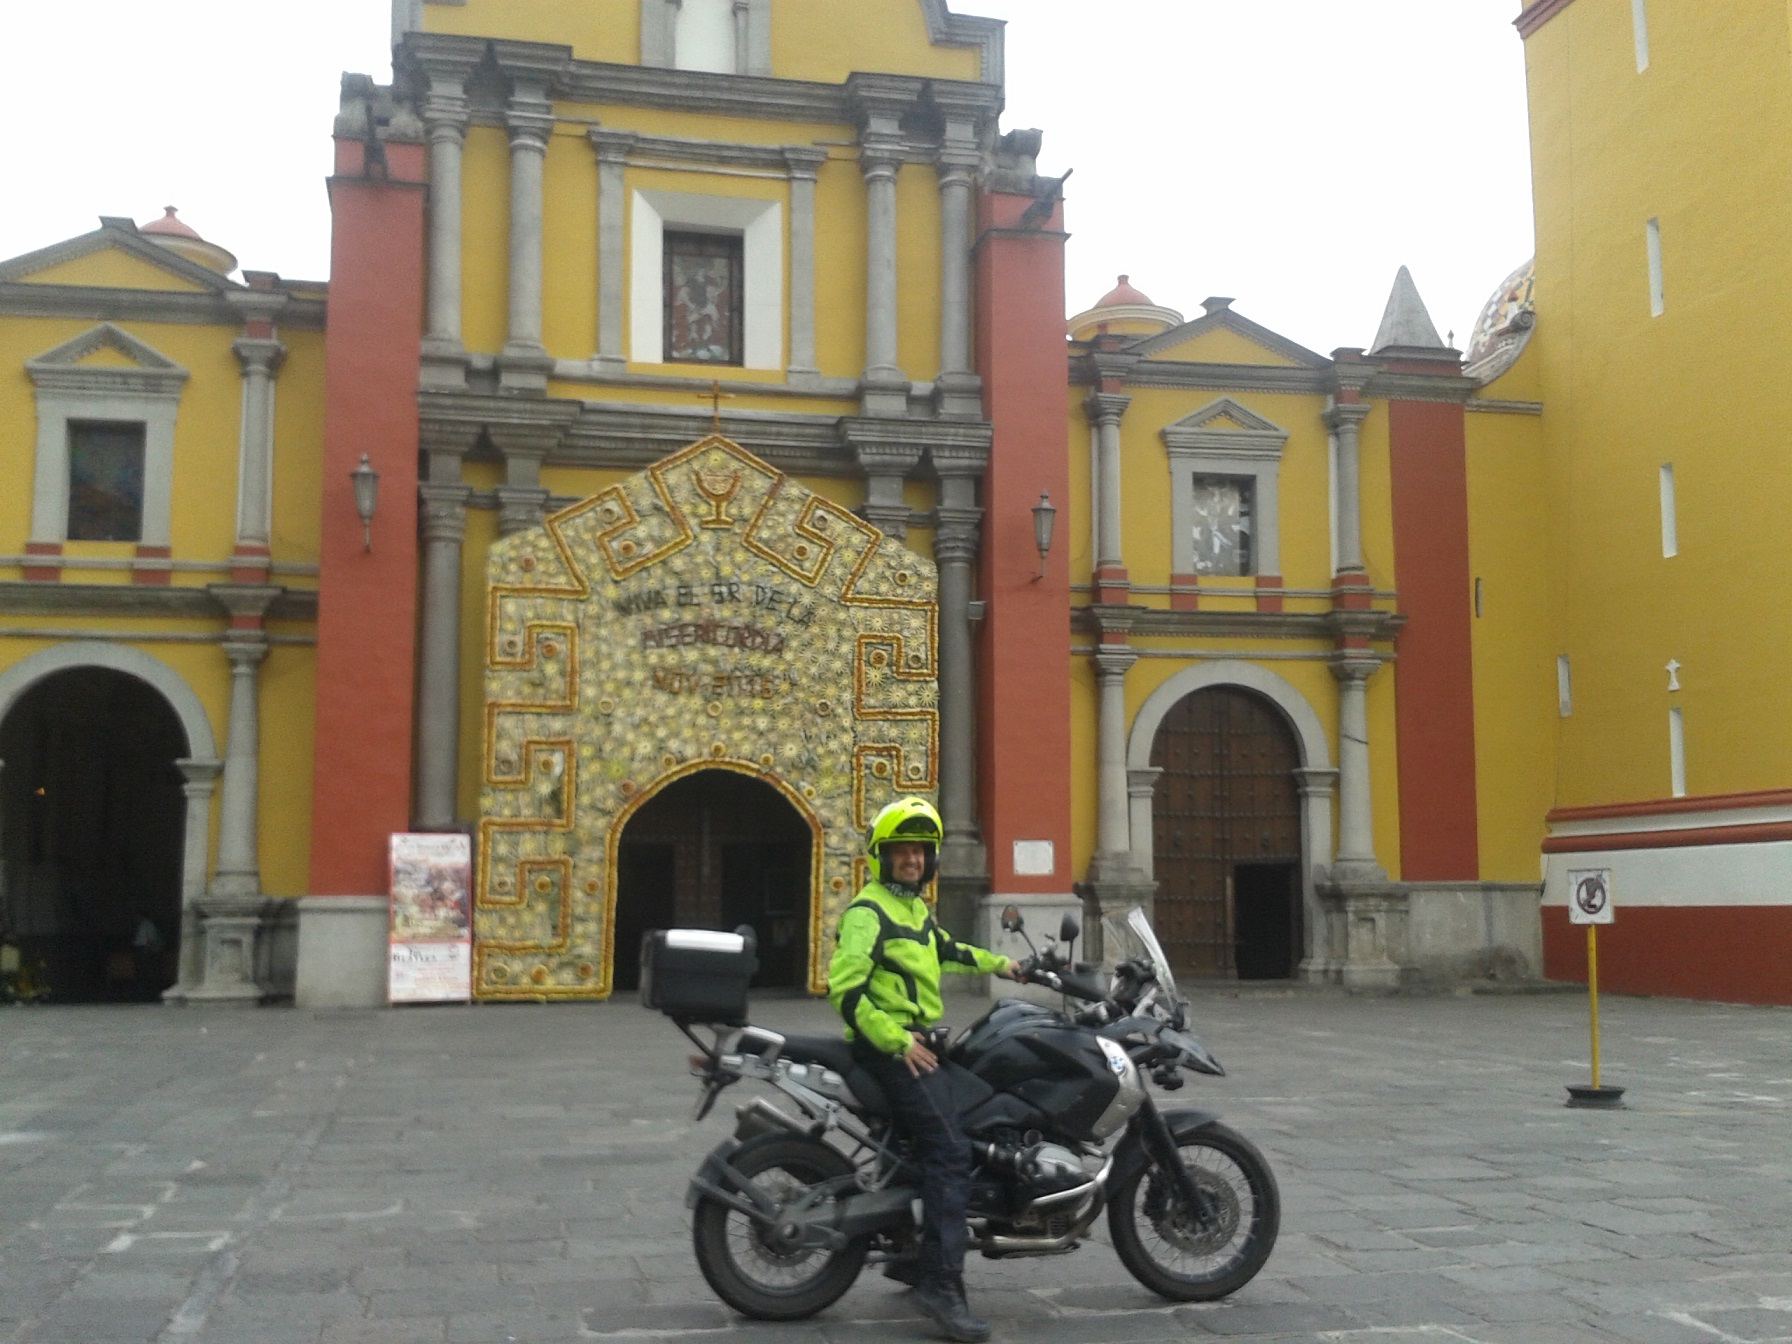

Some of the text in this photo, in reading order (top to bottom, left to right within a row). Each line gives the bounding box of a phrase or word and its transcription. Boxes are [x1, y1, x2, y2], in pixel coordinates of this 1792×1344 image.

[677, 585, 700, 607] EL
[711, 582, 741, 604] SR
[756, 584, 785, 611] DE
[786, 598, 815, 630] LA
[641, 622, 785, 658] MISERICORDIA
